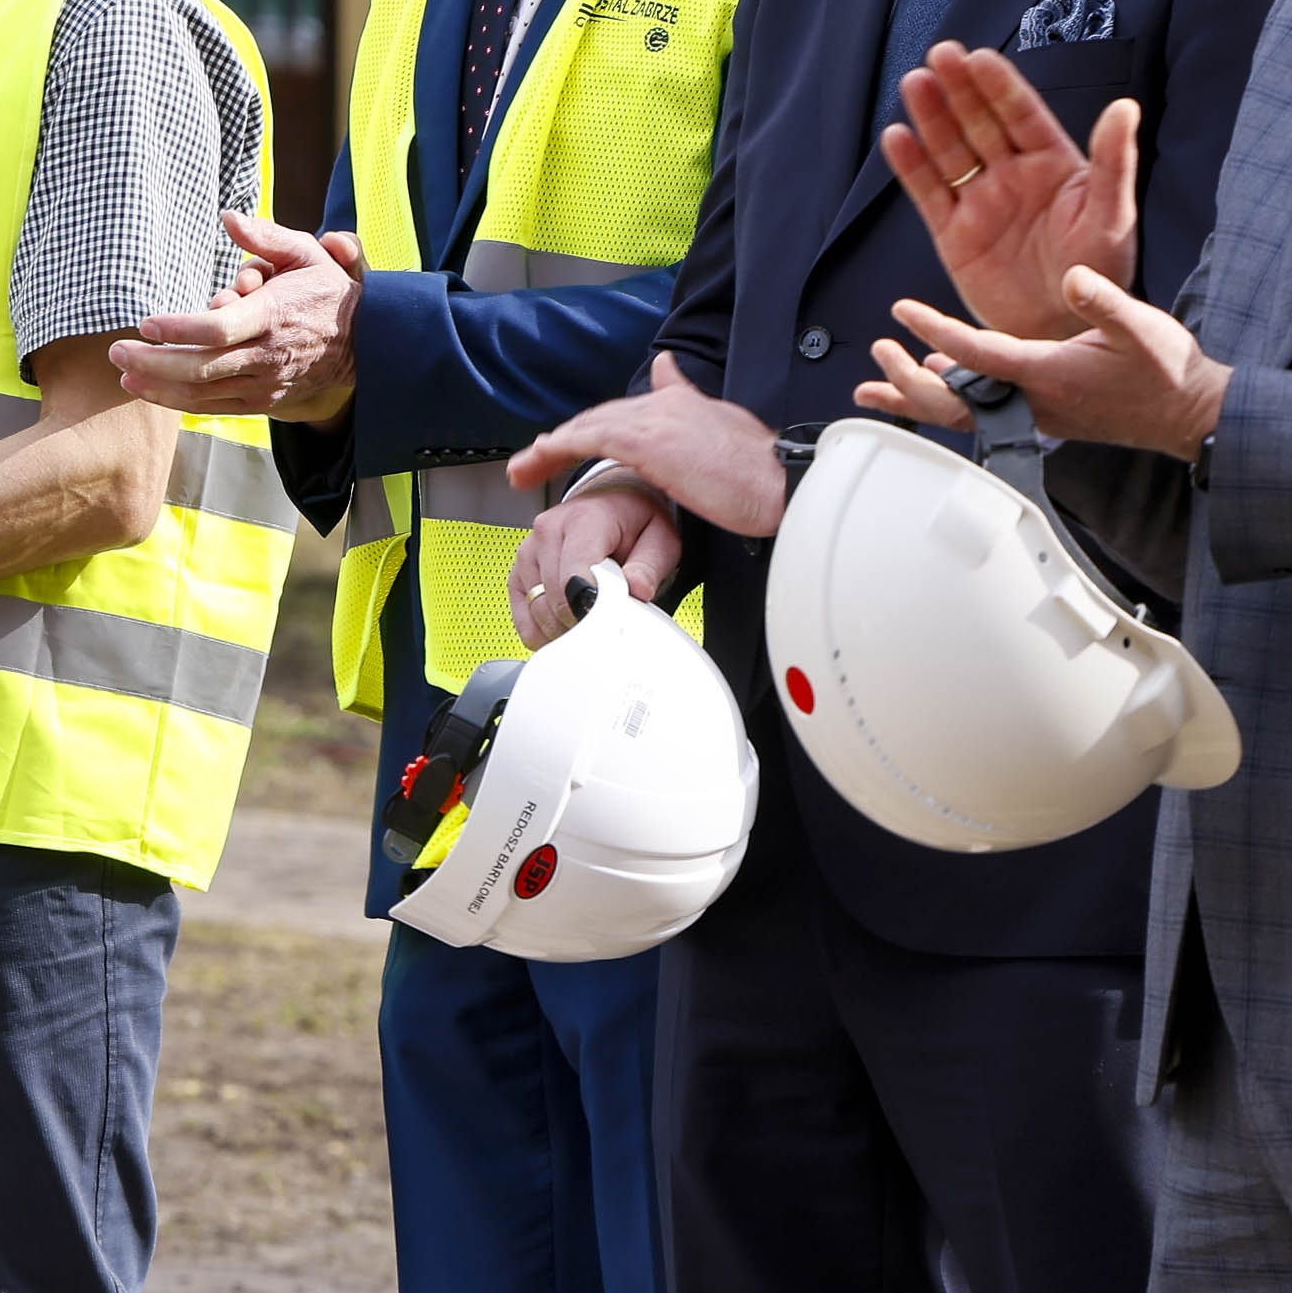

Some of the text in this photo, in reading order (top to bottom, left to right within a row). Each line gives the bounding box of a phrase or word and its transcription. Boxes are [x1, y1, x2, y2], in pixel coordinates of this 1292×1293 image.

[631, 0, 680, 25] ZABRZE
[503, 800, 537, 853] REDOSZ
[523, 851, 550, 893] JSP
